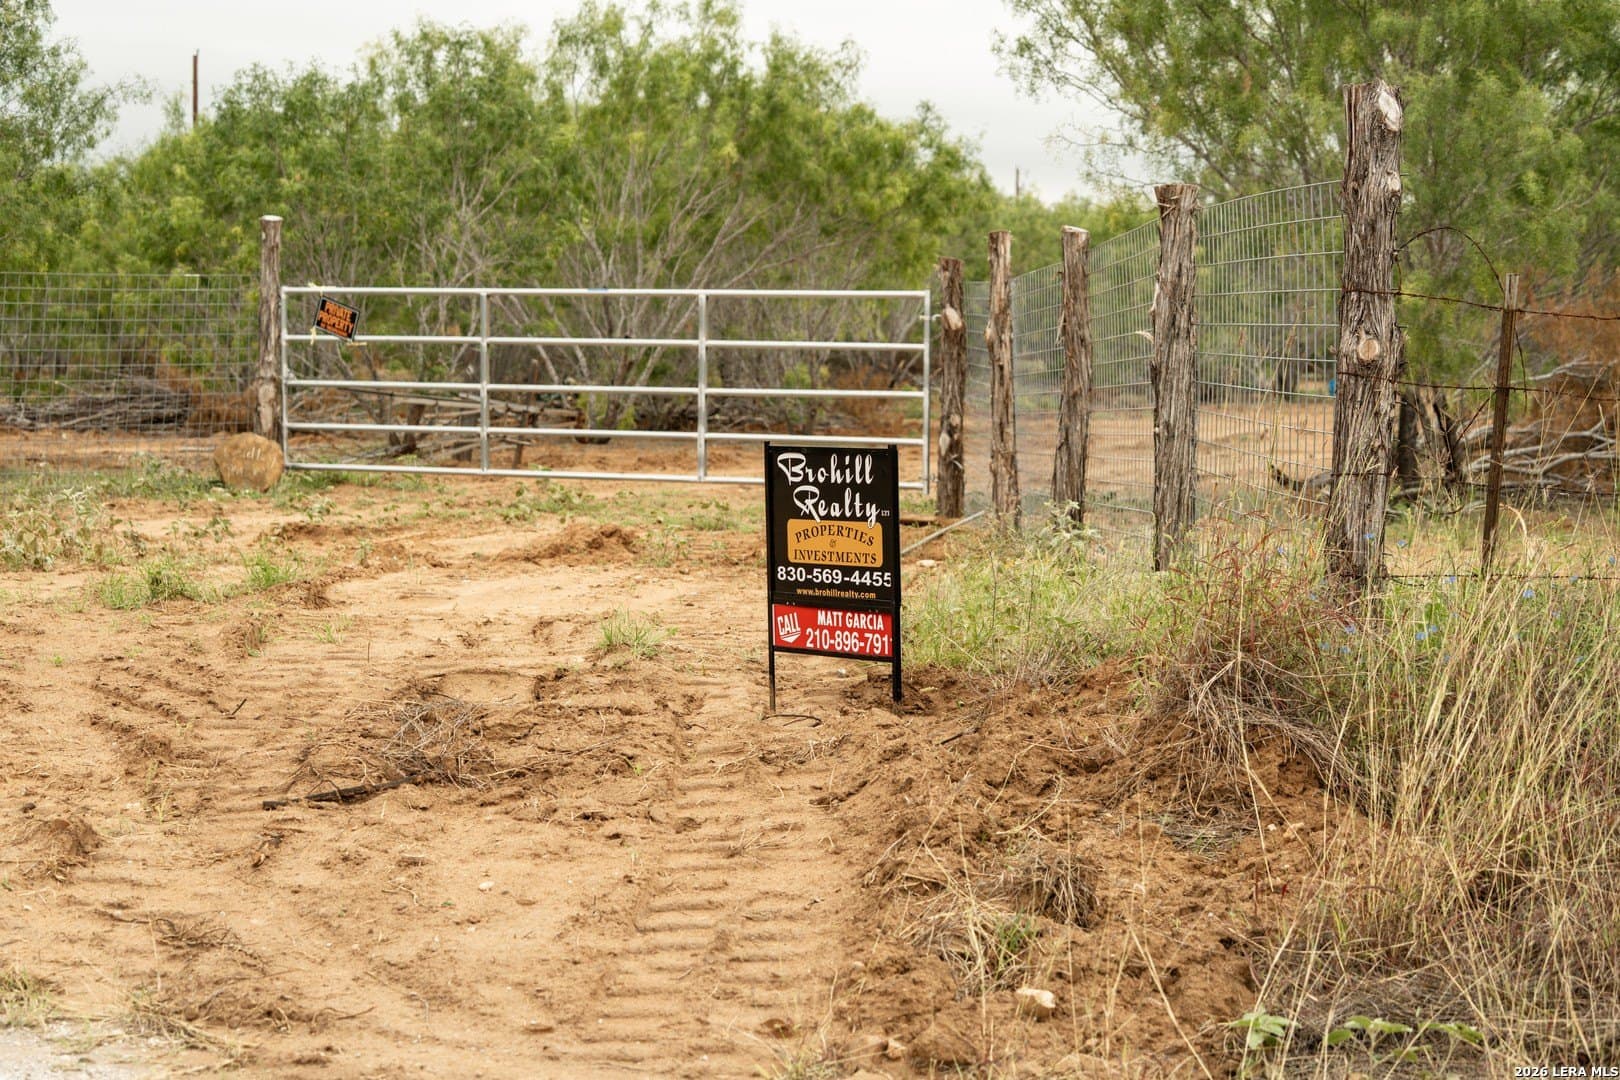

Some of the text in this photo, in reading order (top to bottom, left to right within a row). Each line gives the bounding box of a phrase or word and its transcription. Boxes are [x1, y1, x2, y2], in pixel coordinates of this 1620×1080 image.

[318, 310, 354, 334] PROPERTY
[325, 301, 353, 321] PRIVATE
[777, 452, 874, 486] Brohill
[793, 485, 880, 528] Realty
[795, 524, 875, 547] PROPERTIES
[794, 549, 877, 565] INVESTMENTS
[777, 566, 892, 587] 830-569-4455
[796, 588, 877, 599] www.brohillrealty.com
[777, 612, 801, 636] CALL
[817, 610, 884, 631] MATT GARCIA
[805, 628, 893, 654] 210-896-791
